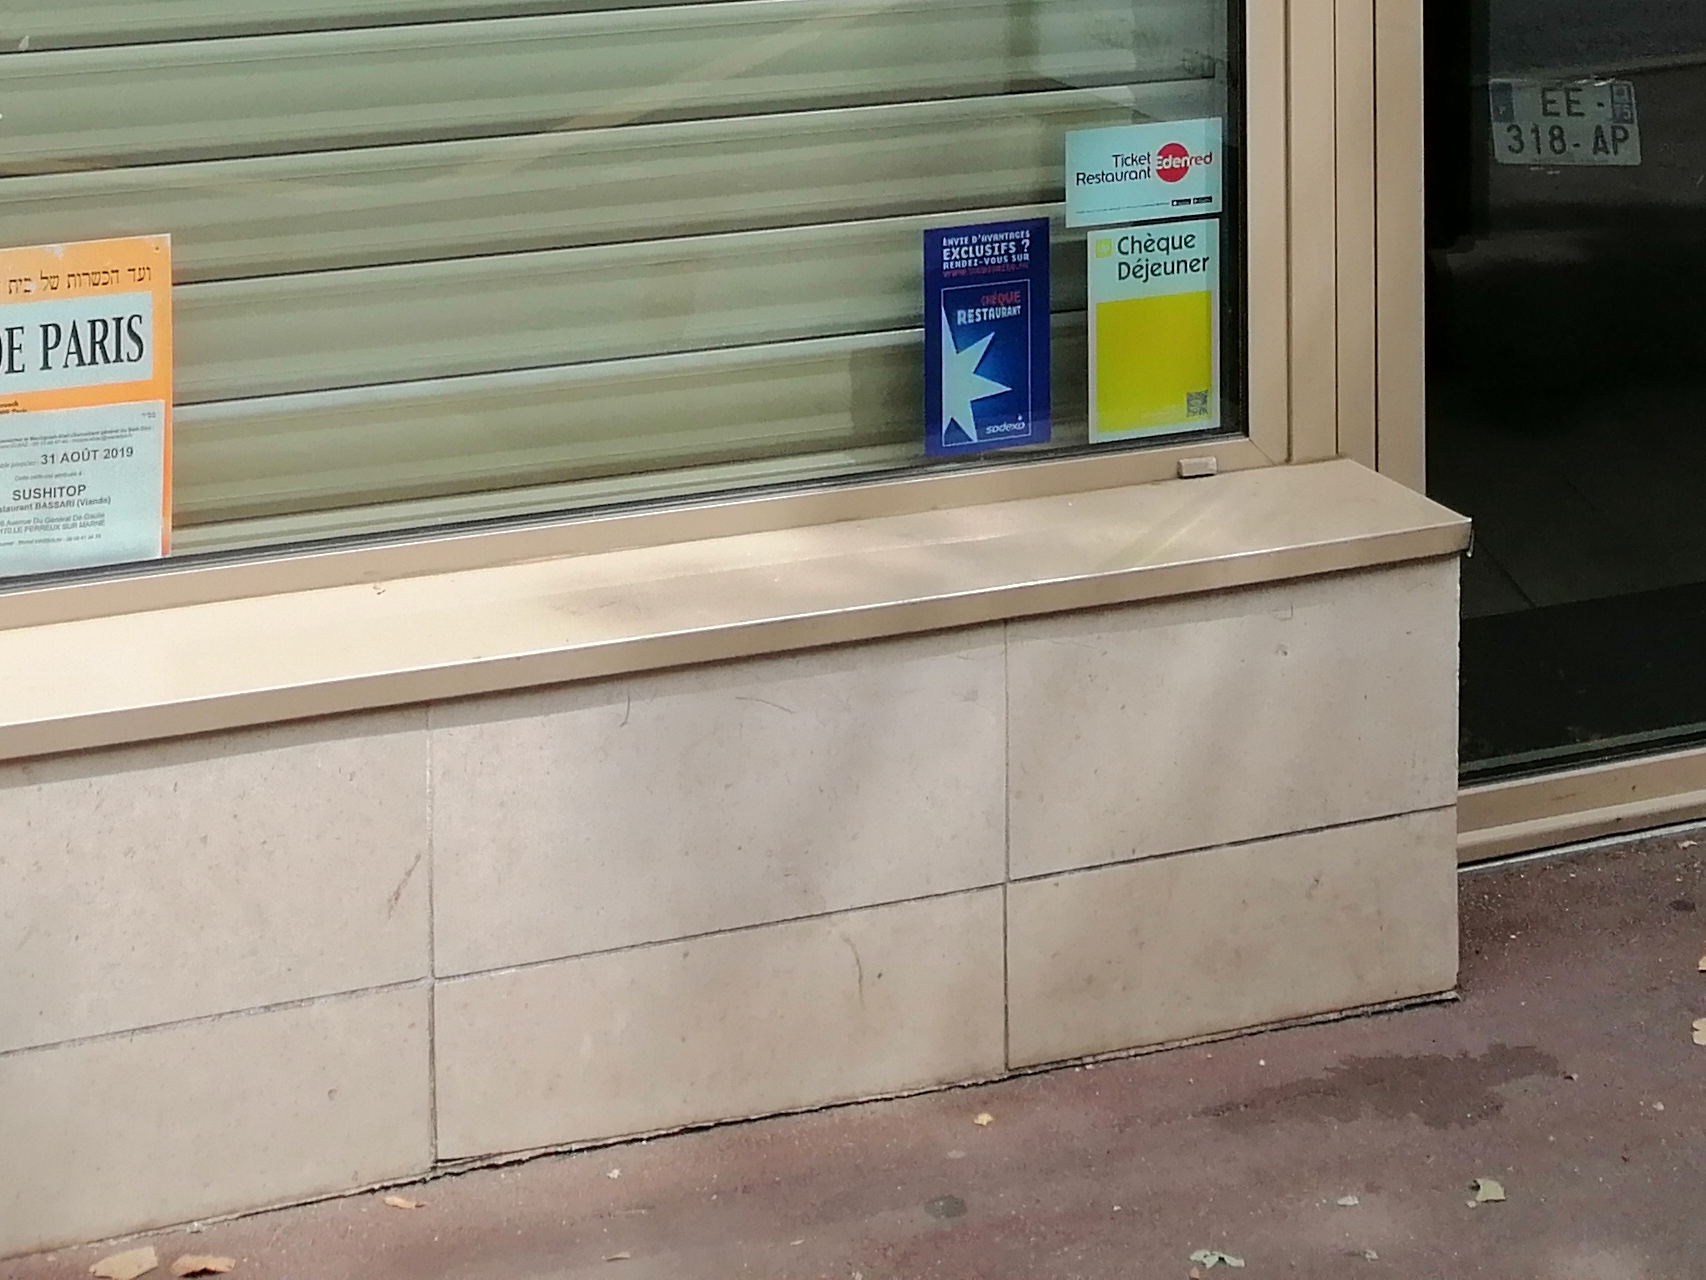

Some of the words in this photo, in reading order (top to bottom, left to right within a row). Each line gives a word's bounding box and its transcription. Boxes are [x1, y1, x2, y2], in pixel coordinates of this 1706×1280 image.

[1112, 152, 1151, 168] Ticket
[1157, 152, 1213, 170] Edenred
[1076, 168, 1151, 186] Restaurant
[943, 236, 969, 246] ENVIE
[972, 230, 1030, 244] D'AVANTAGES
[1117, 233, 1196, 255] Chèque
[943, 241, 1016, 260] EXCLUSIFS
[1021, 239, 1030, 252] ?
[943, 255, 1008, 270] RENDEZ-VOUS
[1012, 253, 1029, 262] SUR
[1118, 256, 1210, 283] Déjeuner
[40, 270, 59, 291] של
[67, 269, 119, 289] הכשרות
[127, 266, 151, 282] ועד
[957, 305, 1021, 325] RESTAURANT
[40, 314, 143, 371] PARIS
[985, 419, 1025, 434] sodexo
[40, 453, 54, 465] 31
[60, 446, 99, 464] AOÛT
[103, 445, 133, 459] 2019
[11, 483, 86, 501] SUSHITOP
[23, 523, 60, 532] PERREUX
[78, 520, 105, 528] MARNE
